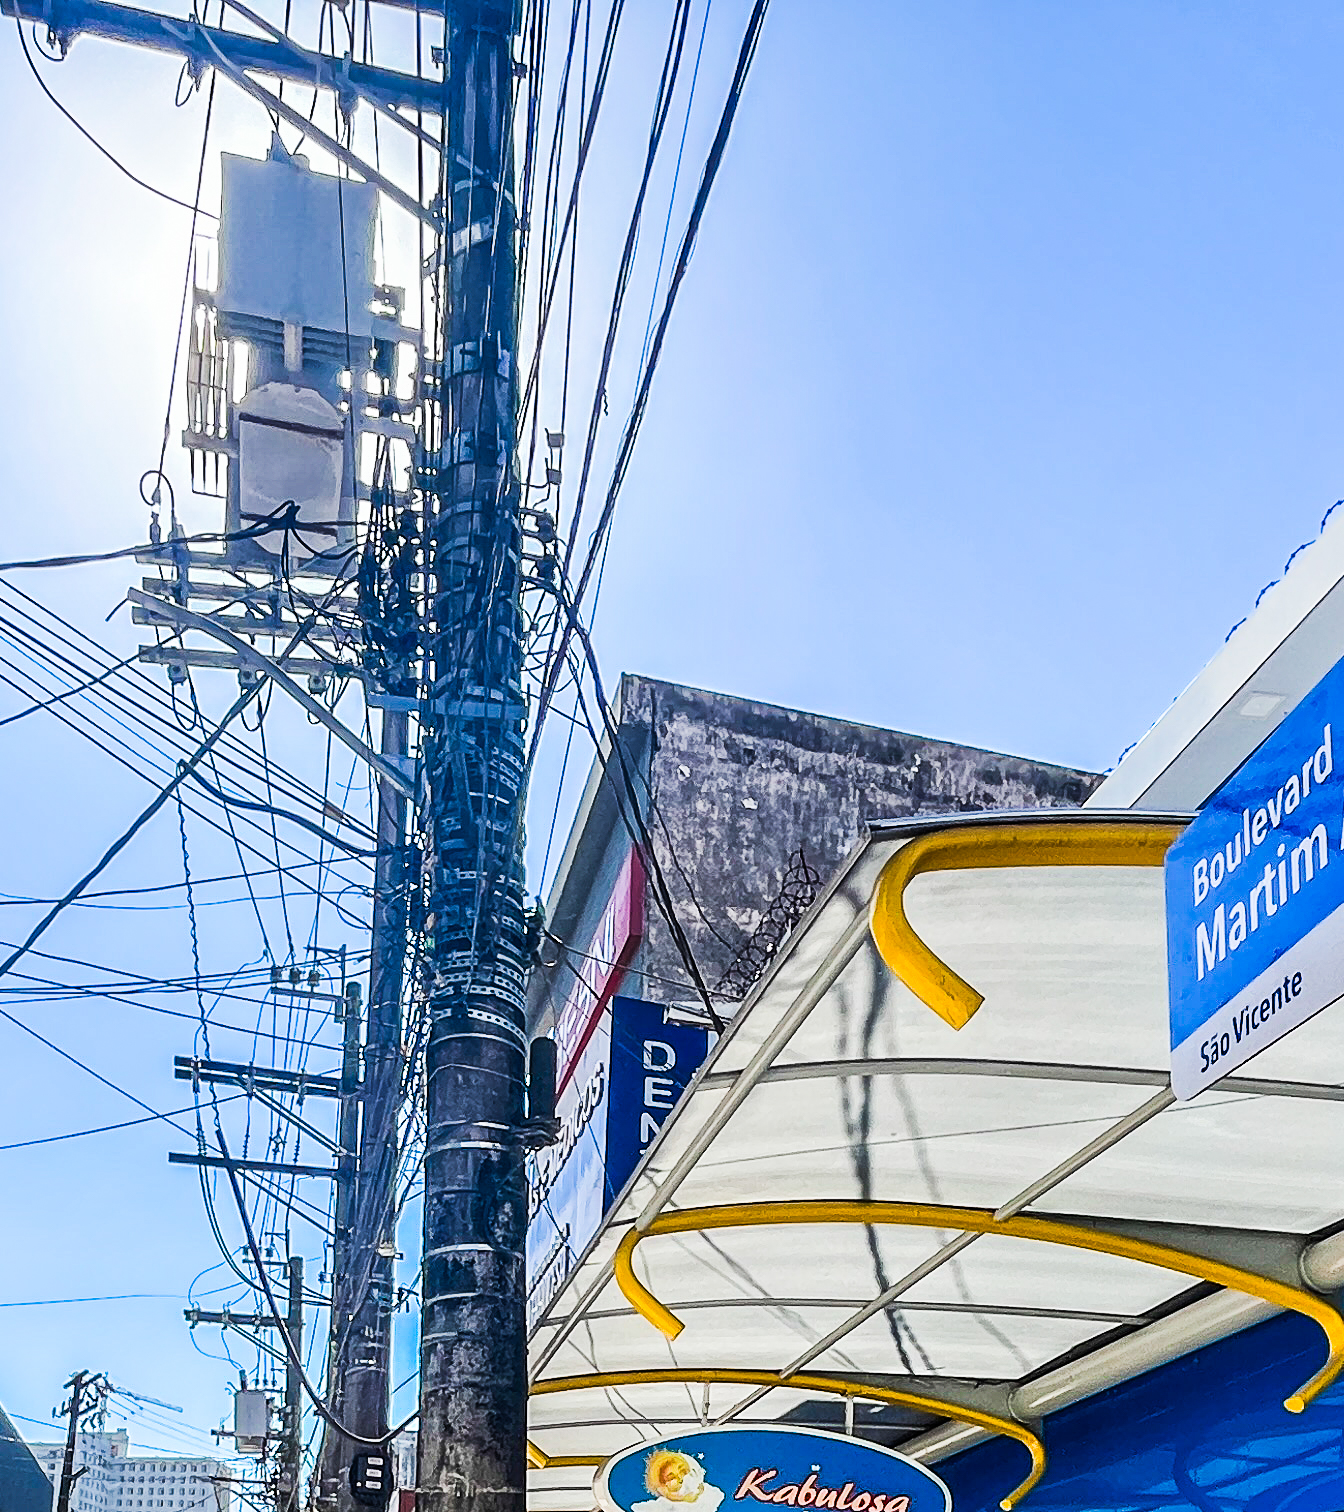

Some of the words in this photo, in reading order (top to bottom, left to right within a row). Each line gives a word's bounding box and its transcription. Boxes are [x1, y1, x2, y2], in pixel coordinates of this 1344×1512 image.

[1193, 724, 1333, 907] Boulevard
[1196, 830, 1329, 982] Martim
[1200, 1034, 1231, 1074] São
[1233, 971, 1304, 1044] Vicente
[640, 1039, 677, 1156] DEN
